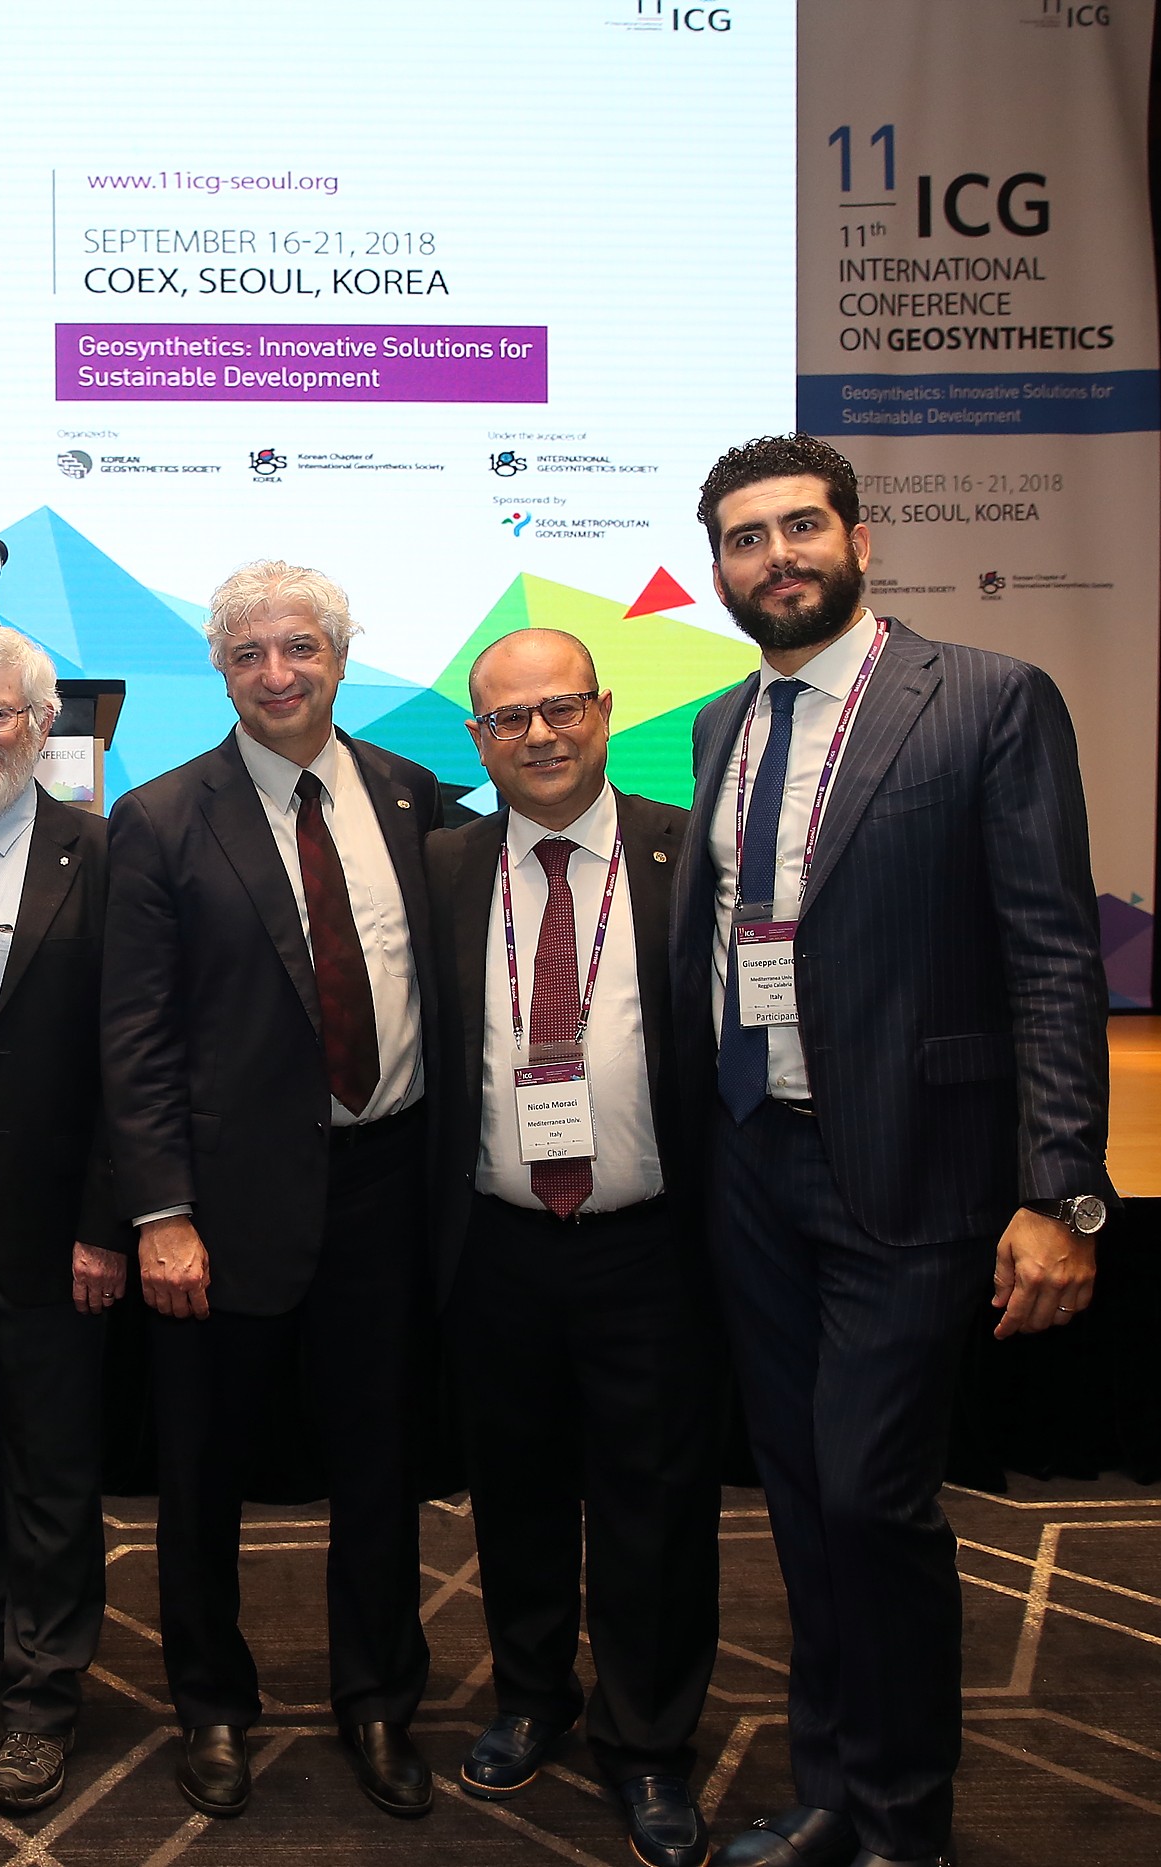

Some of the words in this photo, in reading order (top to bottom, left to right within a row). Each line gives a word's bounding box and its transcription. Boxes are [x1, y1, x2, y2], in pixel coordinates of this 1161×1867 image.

[673, 8, 731, 31] ICG
[1067, 5, 1110, 28] ICG
[829, 124, 894, 192] 11
[87, 170, 339, 194] www.11icg-seoul.org
[918, 172, 1050, 238] ICG
[84, 229, 256, 254] SEPTEMBER
[365, 231, 436, 256] 2018
[840, 222, 886, 248] 11th
[840, 257, 1046, 282] INTERNATIONAL
[84, 268, 187, 297] COEX,
[200, 268, 322, 297] SEOUL,
[334, 269, 450, 295] KOREA
[840, 292, 1011, 317] CONFERENCE
[840, 328, 881, 351] ON
[887, 325, 1114, 351] GEOSYNTHETICS
[78, 336, 252, 361] Geosynthetics:
[259, 337, 377, 359] Innovative
[382, 337, 493, 359] Solutions
[498, 337, 533, 359] for
[78, 366, 217, 388] Sustainable
[223, 367, 380, 392] Development
[842, 385, 945, 404] Geosynthetics:
[949, 384, 1019, 399] Innovative
[1023, 384, 1087, 399] Solutions
[1091, 384, 1114, 398] for
[842, 408, 922, 424] Sustainable
[927, 408, 1021, 426] Development
[108, 430, 120, 439] by
[488, 432, 516, 440] Under
[519, 432, 534, 440] the
[577, 432, 588, 440] of
[330, 453, 363, 461] Chapter
[354, 463, 412, 471] Geosynthetics
[415, 463, 445, 471] Society
[537, 465, 616, 473] GEOSYNTHETICS
[619, 465, 659, 473] SOCIETY
[856, 474, 946, 494] EPTEMBER
[1019, 473, 1064, 492] 2018
[492, 496, 550, 505] Sponsored
[553, 496, 567, 506] by
[535, 519, 567, 527] SEOUL
[572, 519, 650, 528] METROPOLITAN
[860, 504, 896, 526] OEX,
[902, 503, 970, 524] SEOUL,
[975, 503, 1040, 522] KOREA
[41, 750, 86, 760] NFERENCE
[742, 959, 777, 967] Giuseppe
[756, 1012, 799, 1021] Participant
[527, 1101, 550, 1111] Nicola
[552, 1099, 578, 1109] Moraci
[527, 1119, 565, 1127] Mediterranea
[547, 1149, 568, 1157] Chair
